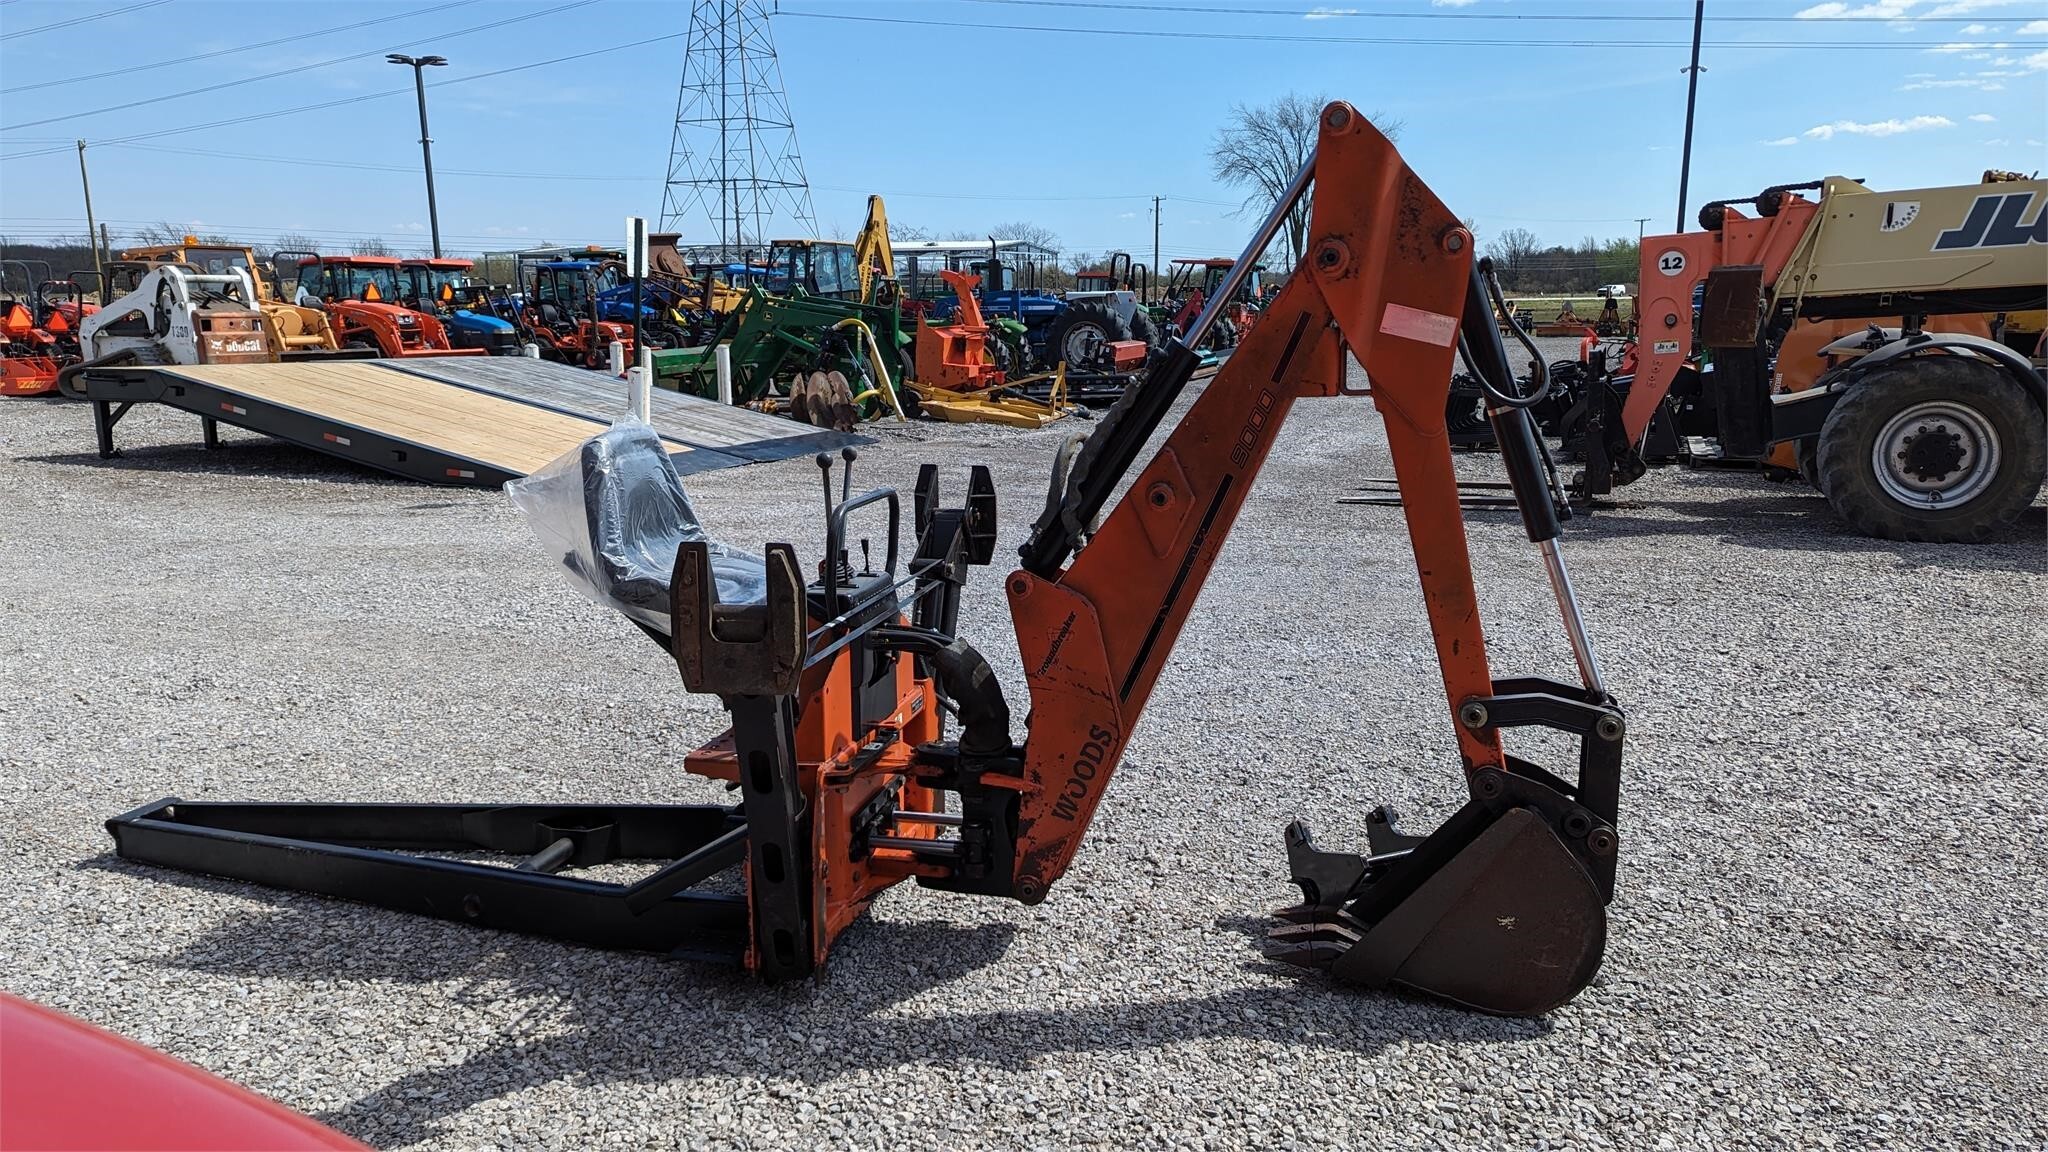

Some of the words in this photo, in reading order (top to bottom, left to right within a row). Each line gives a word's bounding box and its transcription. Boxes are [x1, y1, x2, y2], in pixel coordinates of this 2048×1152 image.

[1661, 256, 1683, 270] 12
[1231, 388, 1276, 469] 9000
[1051, 724, 1112, 821] WOODS
